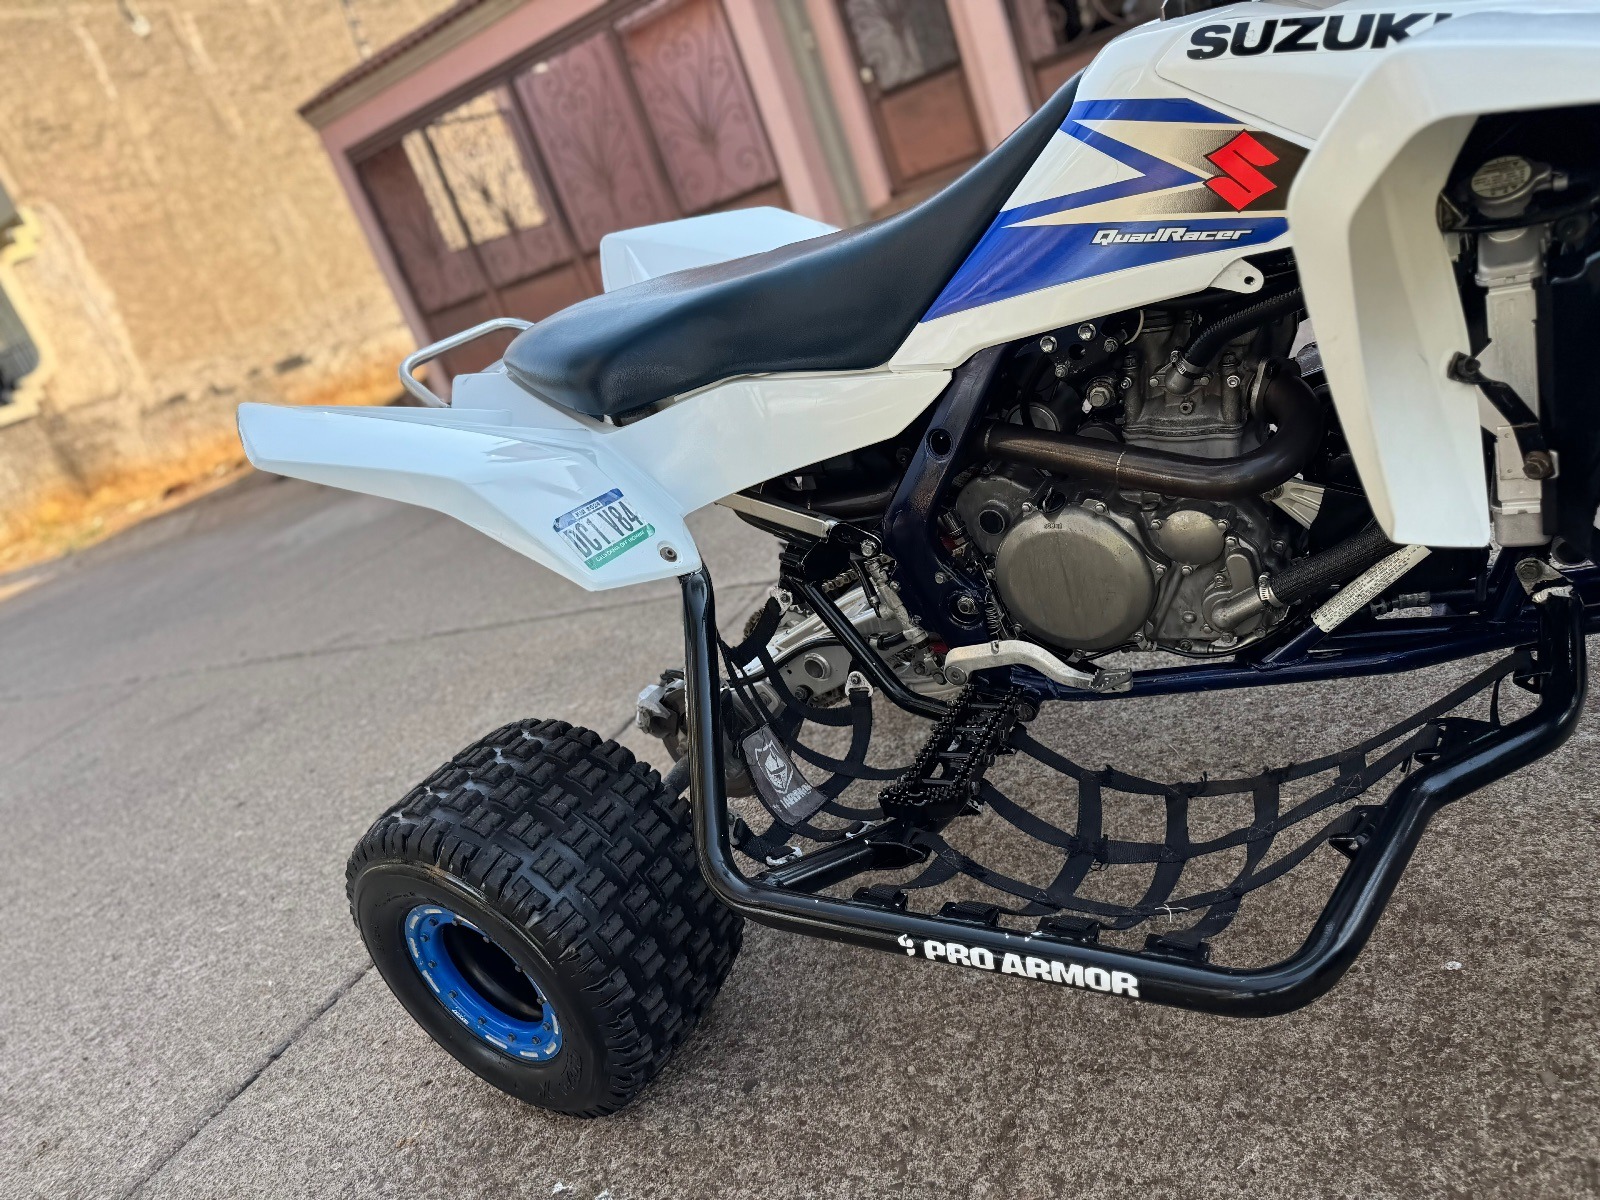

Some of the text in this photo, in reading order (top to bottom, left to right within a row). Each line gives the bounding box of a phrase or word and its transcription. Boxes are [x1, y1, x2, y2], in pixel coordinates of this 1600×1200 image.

[1092, 227, 1252, 246] QuadRacer
[597, 500, 644, 537] V84
[923, 940, 1140, 998] PRO ARMOR
